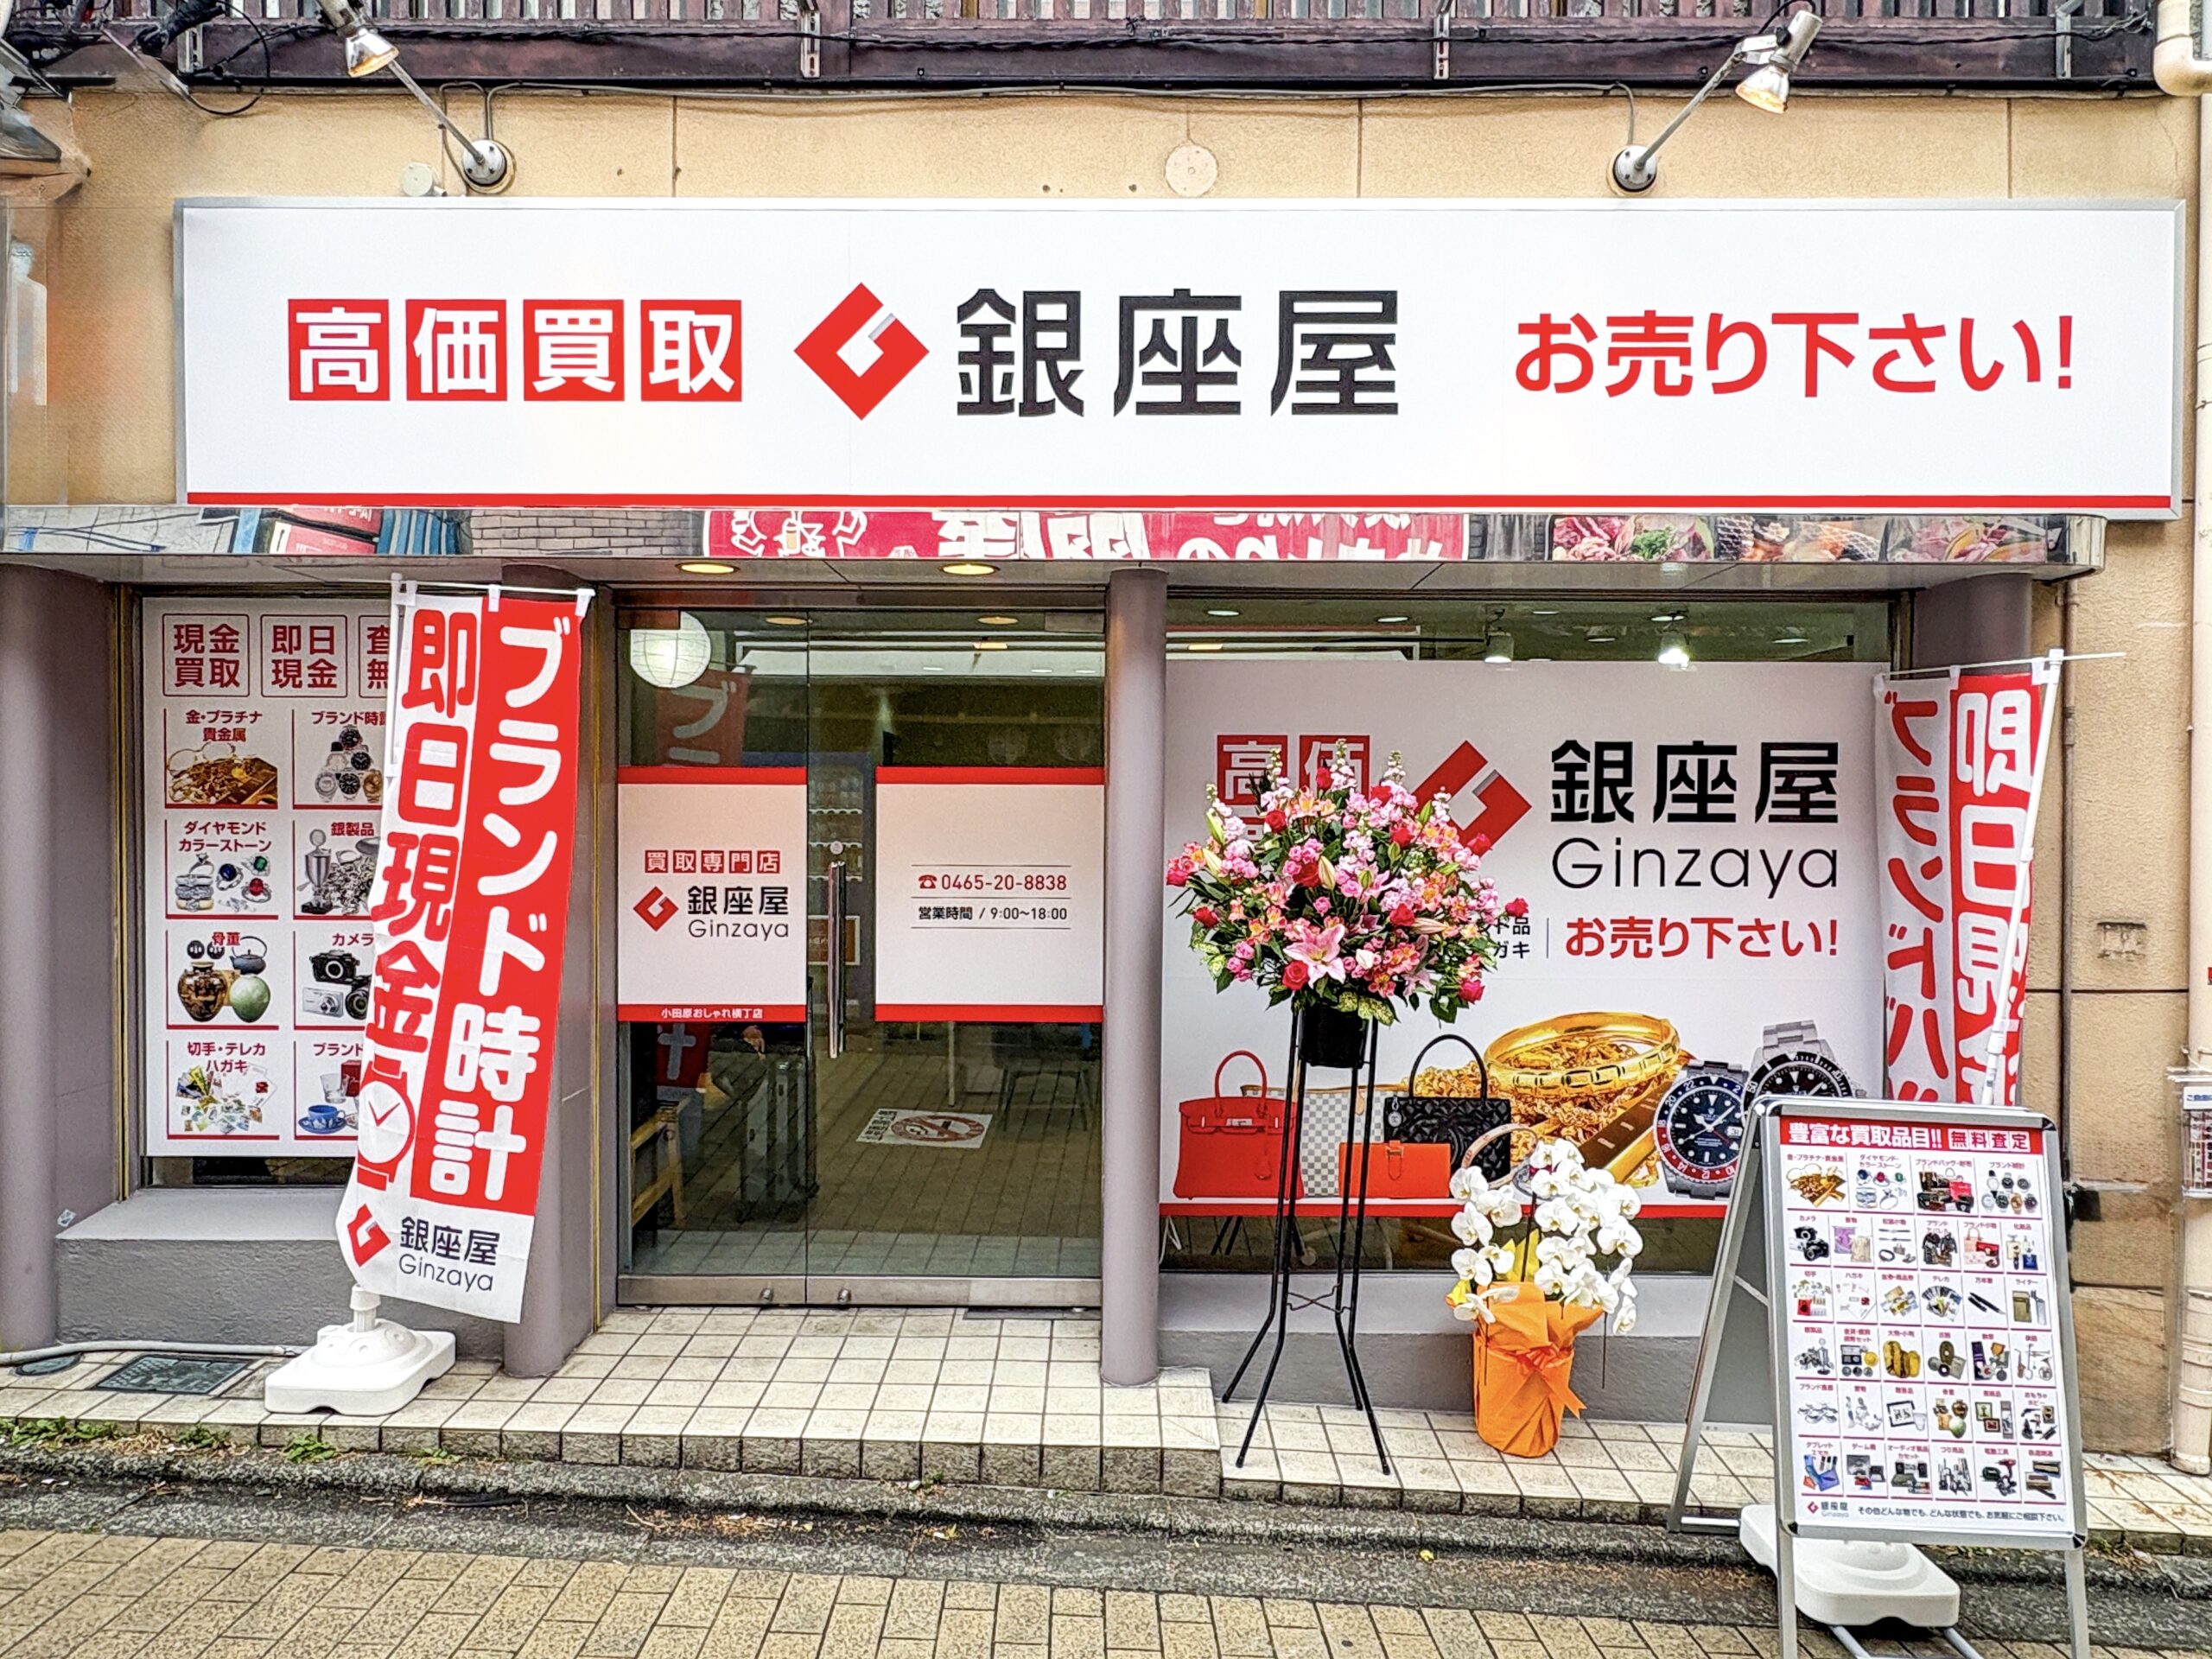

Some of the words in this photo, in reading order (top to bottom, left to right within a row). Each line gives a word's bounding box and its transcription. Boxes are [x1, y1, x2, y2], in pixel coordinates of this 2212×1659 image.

[293, 305, 736, 396] 高価買取
[956, 288, 1400, 416] 銀座屋
[1515, 313, 2075, 398] お売り下さい!
[173, 624, 241, 654] 現金
[271, 624, 336, 655] 即日
[366, 624, 391, 654] 査
[174, 658, 241, 689] 買取
[271, 658, 338, 689] 現金
[366, 658, 389, 689] 無
[185, 710, 263, 725] 金・プラチナ
[202, 728, 246, 743] 貴金属
[1549, 740, 1840, 824] 銀座屋
[184, 822, 266, 836] ダイヤモンド
[330, 822, 375, 836] 銀製品
[365, 609, 477, 1052] 即日現金
[178, 839, 272, 853] カラーストーン
[645, 849, 781, 874] 買取専門店
[1551, 837, 1839, 899] Ginzaya
[941, 874, 1067, 891] 0465-20-8838
[429, 616, 571, 1201] ブランド時計
[687, 885, 790, 916] 銀座屋
[918, 906, 973, 921] 営業時間
[211, 931, 241, 947] 骨董
[332, 932, 374, 947] カメラ
[688, 919, 790, 942] Ginzaya
[1565, 916, 1838, 960] お売り下さい!
[660, 1007, 764, 1020] 小田原おしゃれ横丁店
[187, 1041, 266, 1056] 切手・テレカ
[313, 1042, 364, 1057] ブランド
[206, 1058, 249, 1073] ハガキ
[1789, 1122, 1942, 1149] 豊富な買取品目!!
[1950, 1130, 2029, 1150] 無料査定
[399, 1216, 500, 1266] 銀座屋
[398, 1253, 494, 1293] Ginzaya
